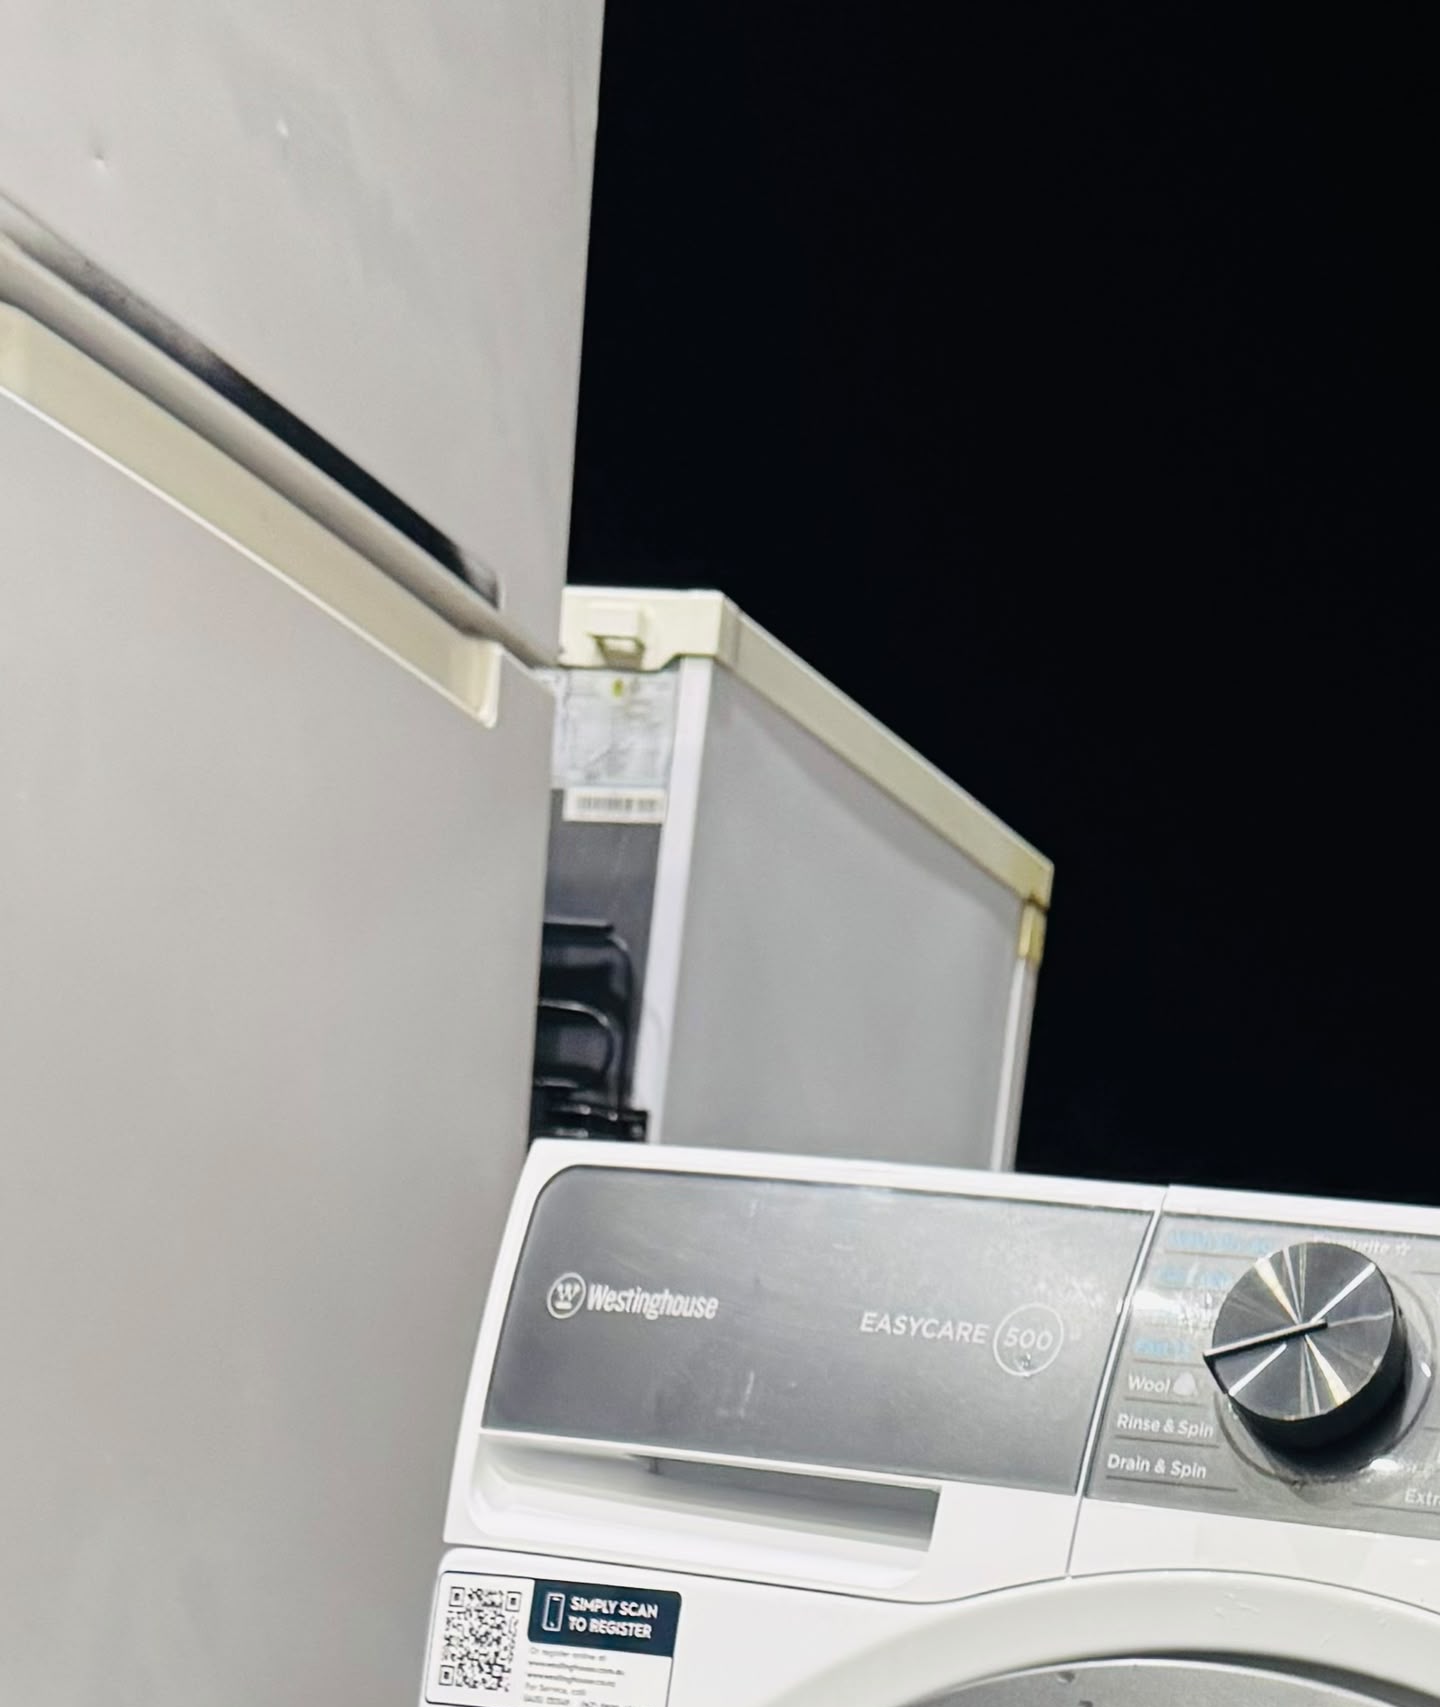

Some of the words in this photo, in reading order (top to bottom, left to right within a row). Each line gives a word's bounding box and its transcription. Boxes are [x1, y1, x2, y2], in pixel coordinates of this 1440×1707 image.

[587, 1282, 719, 1320] Westinghouse
[860, 1311, 990, 1344] EASYCARE
[1003, 1326, 1054, 1351] 500
[1128, 1374, 1171, 1393] Wool
[1117, 1413, 1161, 1432] Rinse
[1163, 1419, 1175, 1433] &
[1178, 1420, 1214, 1438] Spin
[1107, 1453, 1151, 1473] Drain
[1154, 1458, 1166, 1474] &
[1170, 1460, 1207, 1479] Spin
[570, 1595, 618, 1615] SIMPLY
[619, 1601, 659, 1619] SCAN
[568, 1615, 588, 1632] TO
[588, 1618, 652, 1639] REGISTER
